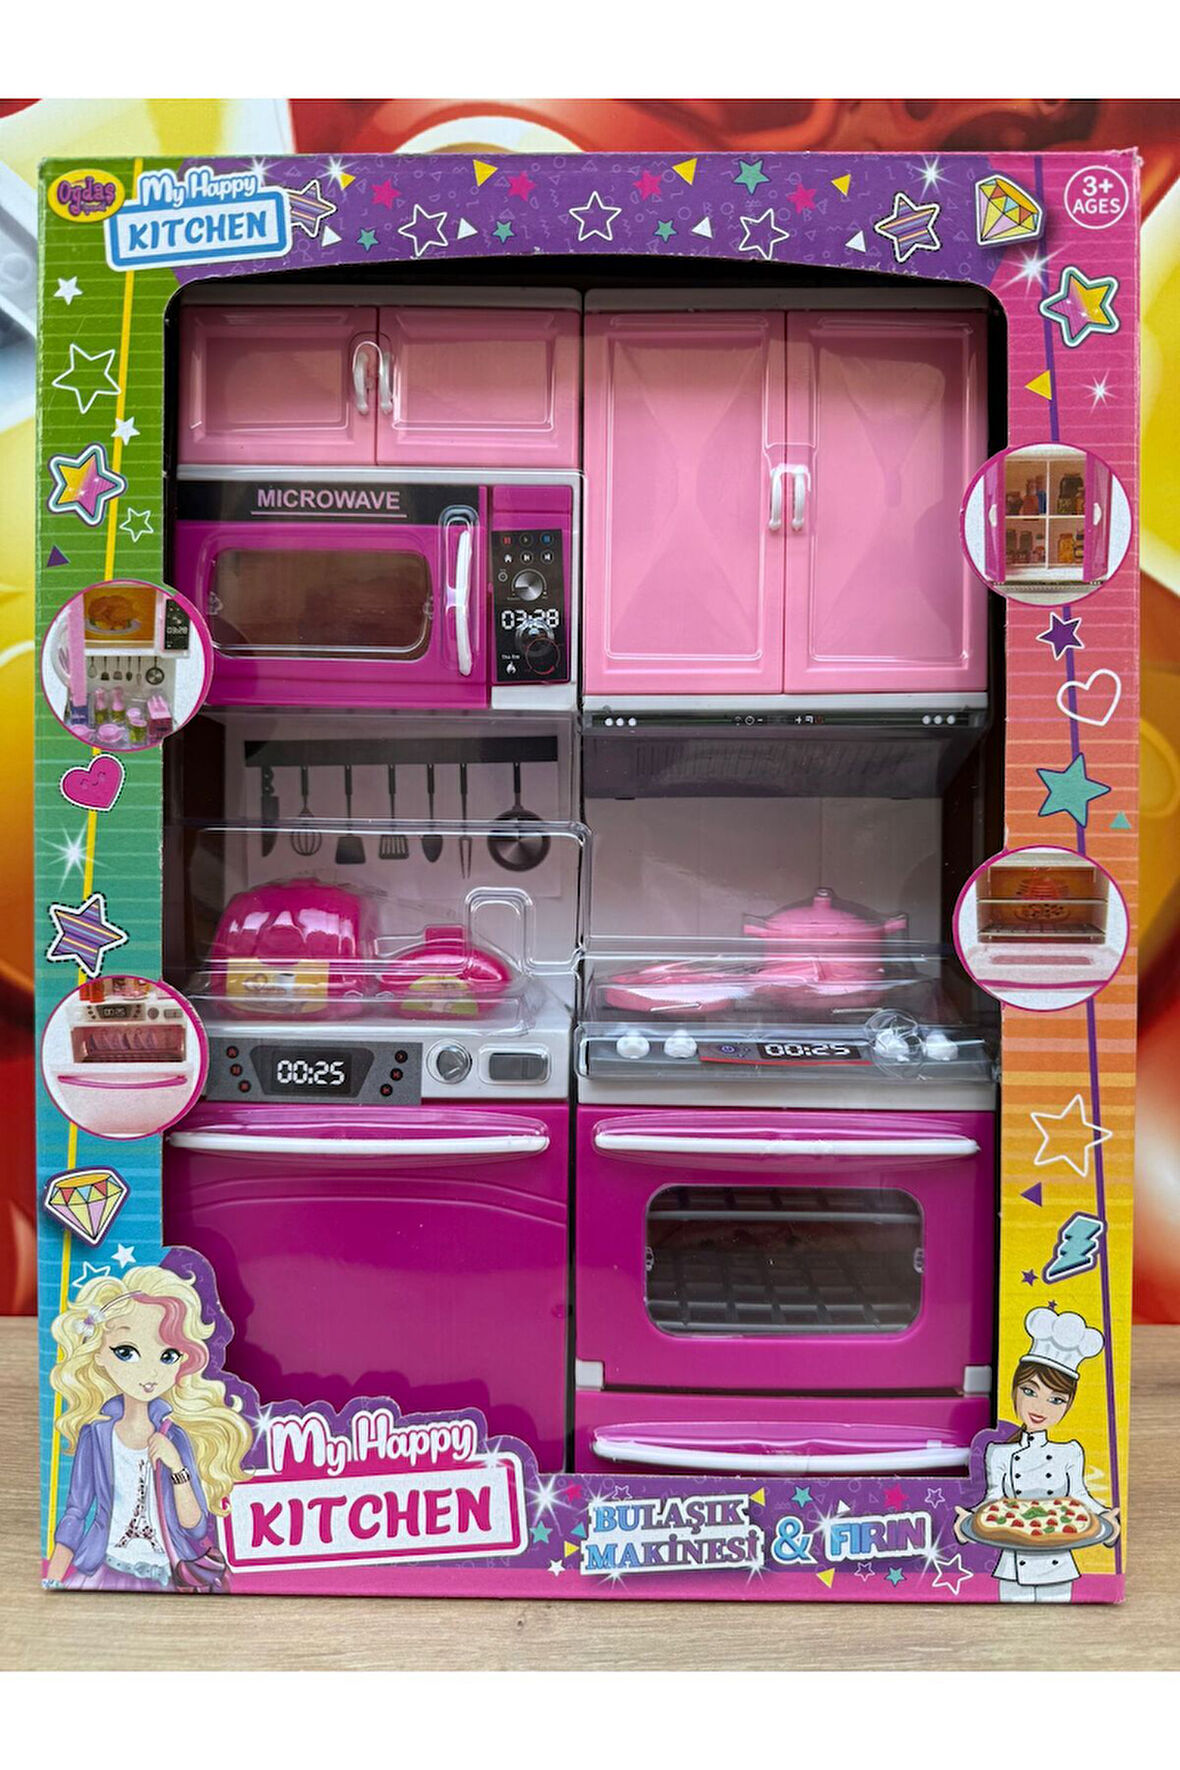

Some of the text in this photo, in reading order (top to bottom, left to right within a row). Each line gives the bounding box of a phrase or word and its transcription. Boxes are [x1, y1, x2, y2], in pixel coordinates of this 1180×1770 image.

[141, 169, 257, 208] My Happy
[1082, 175, 1114, 197] 3+
[1072, 198, 1121, 214] AGES
[128, 210, 267, 251] KITCHEN
[257, 489, 401, 510] MICROWAVE
[763, 1043, 851, 1057] 00:25
[277, 1060, 346, 1085] 00:25
[270, 1410, 474, 1476] My Happy
[250, 1486, 492, 1548] KITCHEN
[593, 1500, 745, 1535] BULAŞIK
[584, 1530, 760, 1570] MAKİNESİ
[773, 1518, 926, 1561] & FIRIN
